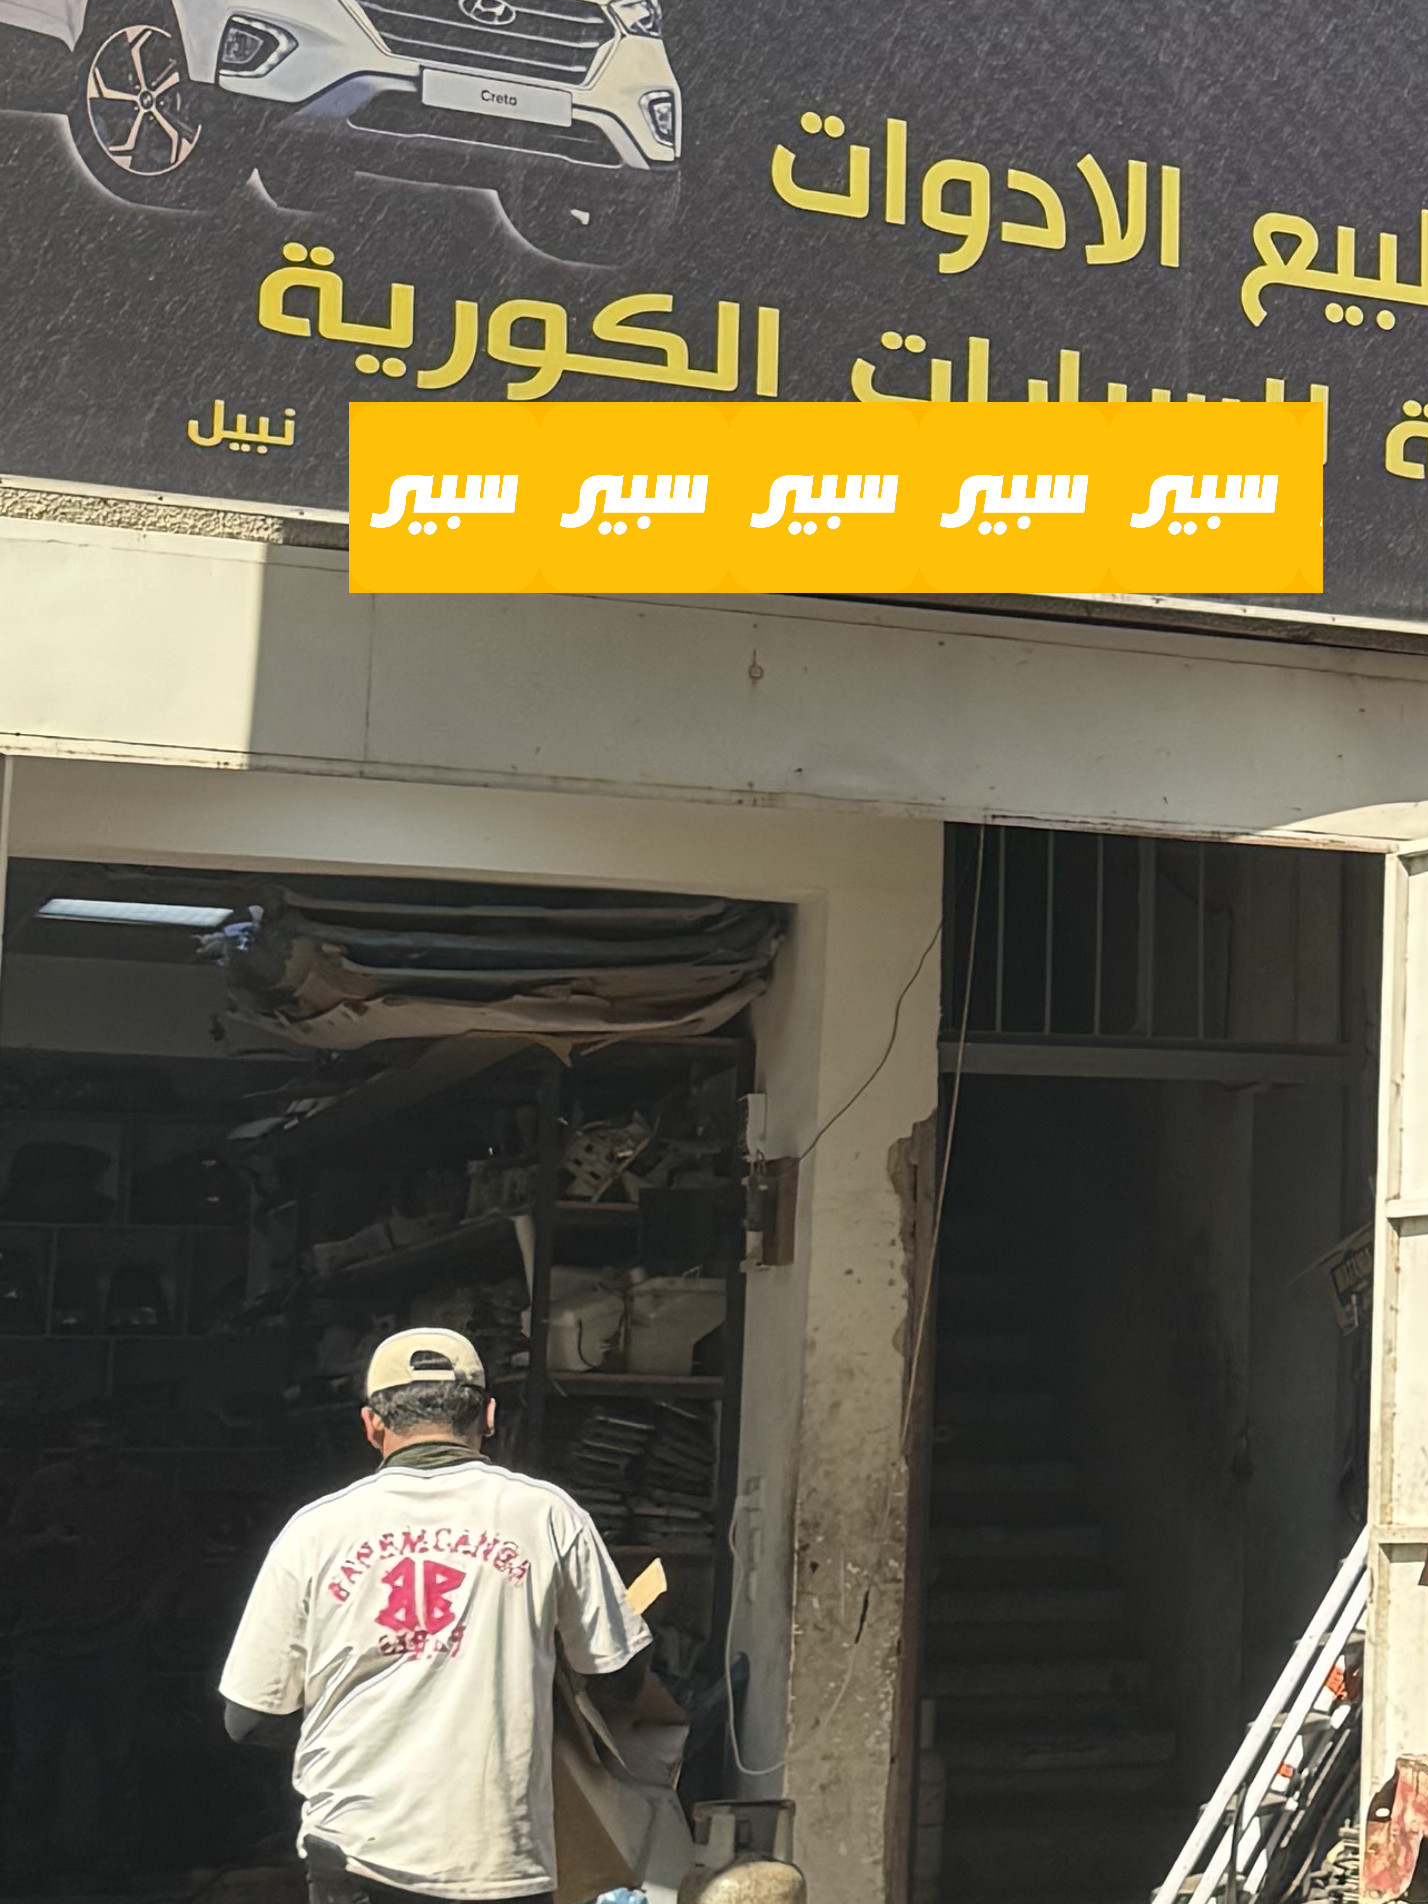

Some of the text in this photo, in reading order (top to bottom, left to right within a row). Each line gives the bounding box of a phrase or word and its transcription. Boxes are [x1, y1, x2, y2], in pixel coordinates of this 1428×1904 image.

[480, 89, 518, 106] Creta
[771, 111, 1181, 275] الادوات
[257, 242, 781, 400] الكورية
[186, 399, 297, 455] نبيل
